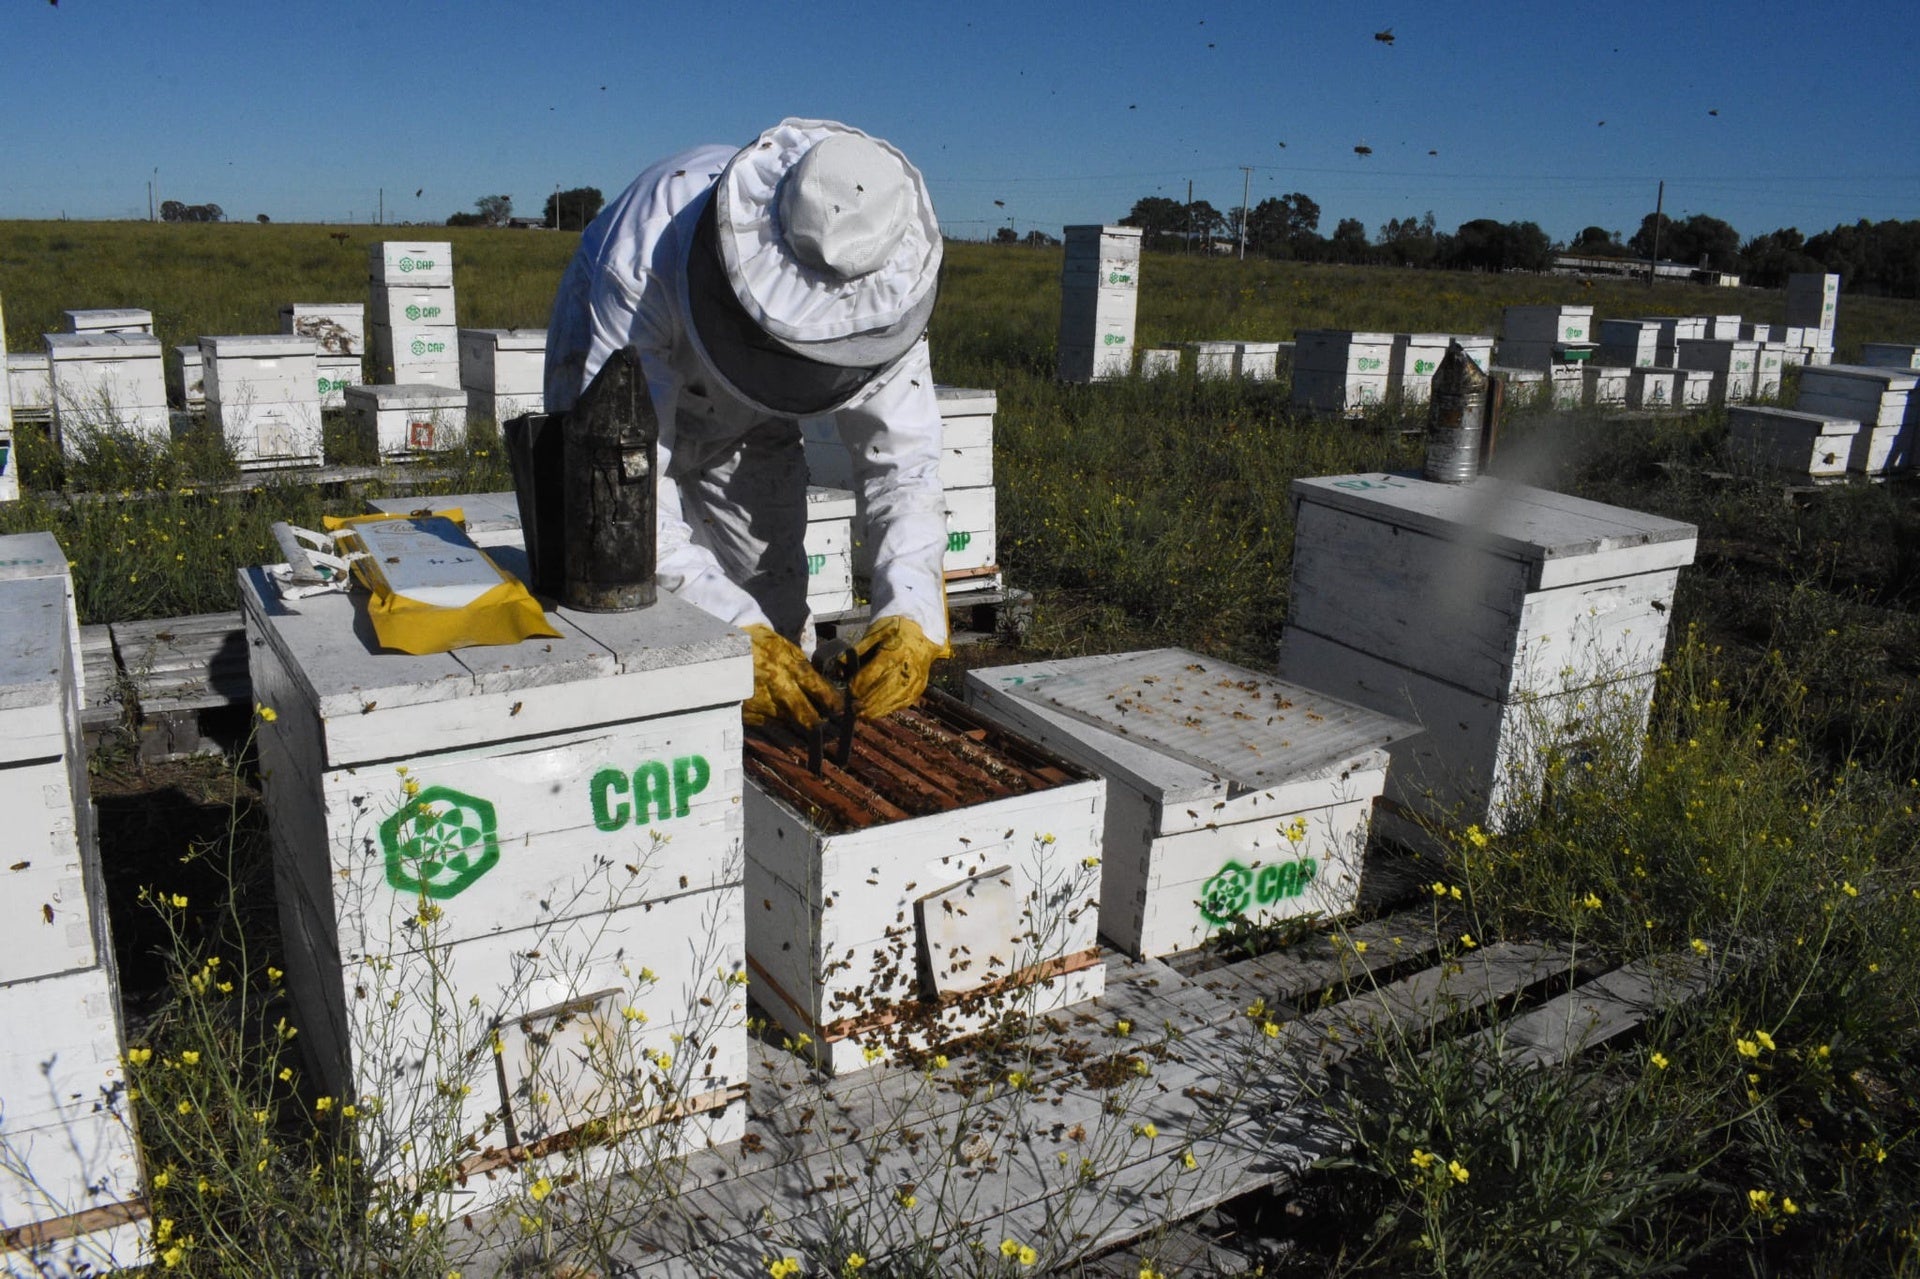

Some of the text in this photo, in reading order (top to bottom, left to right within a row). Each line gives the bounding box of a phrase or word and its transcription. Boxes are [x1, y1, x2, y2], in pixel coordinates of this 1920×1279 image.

[416, 260, 435, 270] CAP
[422, 307, 441, 318] CAP
[427, 343, 445, 353] CAP
[945, 531, 971, 551] AP
[589, 753, 711, 832] CAP
[1256, 858, 1317, 904] CAP
